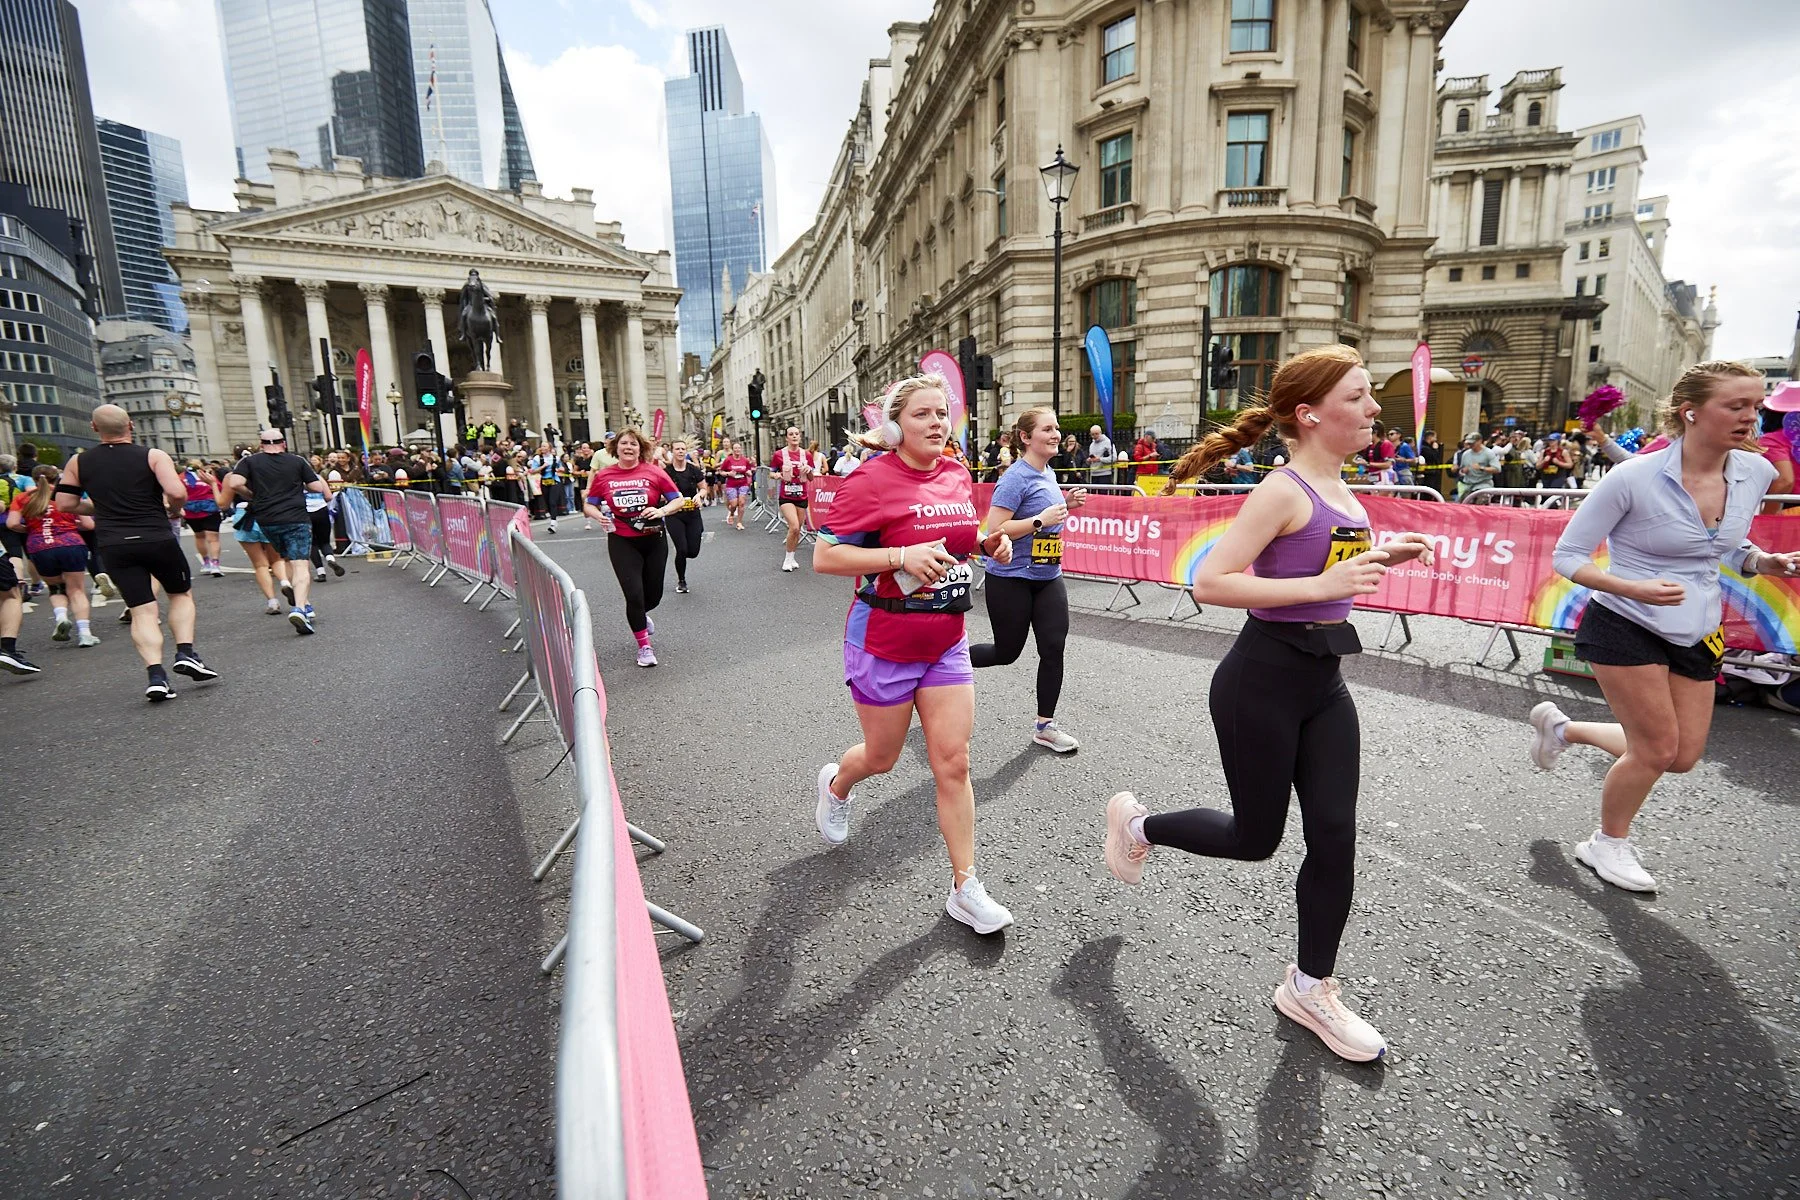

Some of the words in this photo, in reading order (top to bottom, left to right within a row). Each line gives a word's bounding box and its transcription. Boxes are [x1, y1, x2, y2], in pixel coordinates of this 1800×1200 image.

[608, 479, 650, 488] Tommy's
[617, 495, 646, 505] 10643
[1066, 515, 1161, 543] ommy's
[1066, 541, 1098, 551] pregnancy
[1113, 545, 1132, 555] baby
[1133, 547, 1160, 557] charity
[1407, 569, 1428, 578] and
[1431, 569, 1462, 584] baby
[1464, 574, 1510, 590] charity
